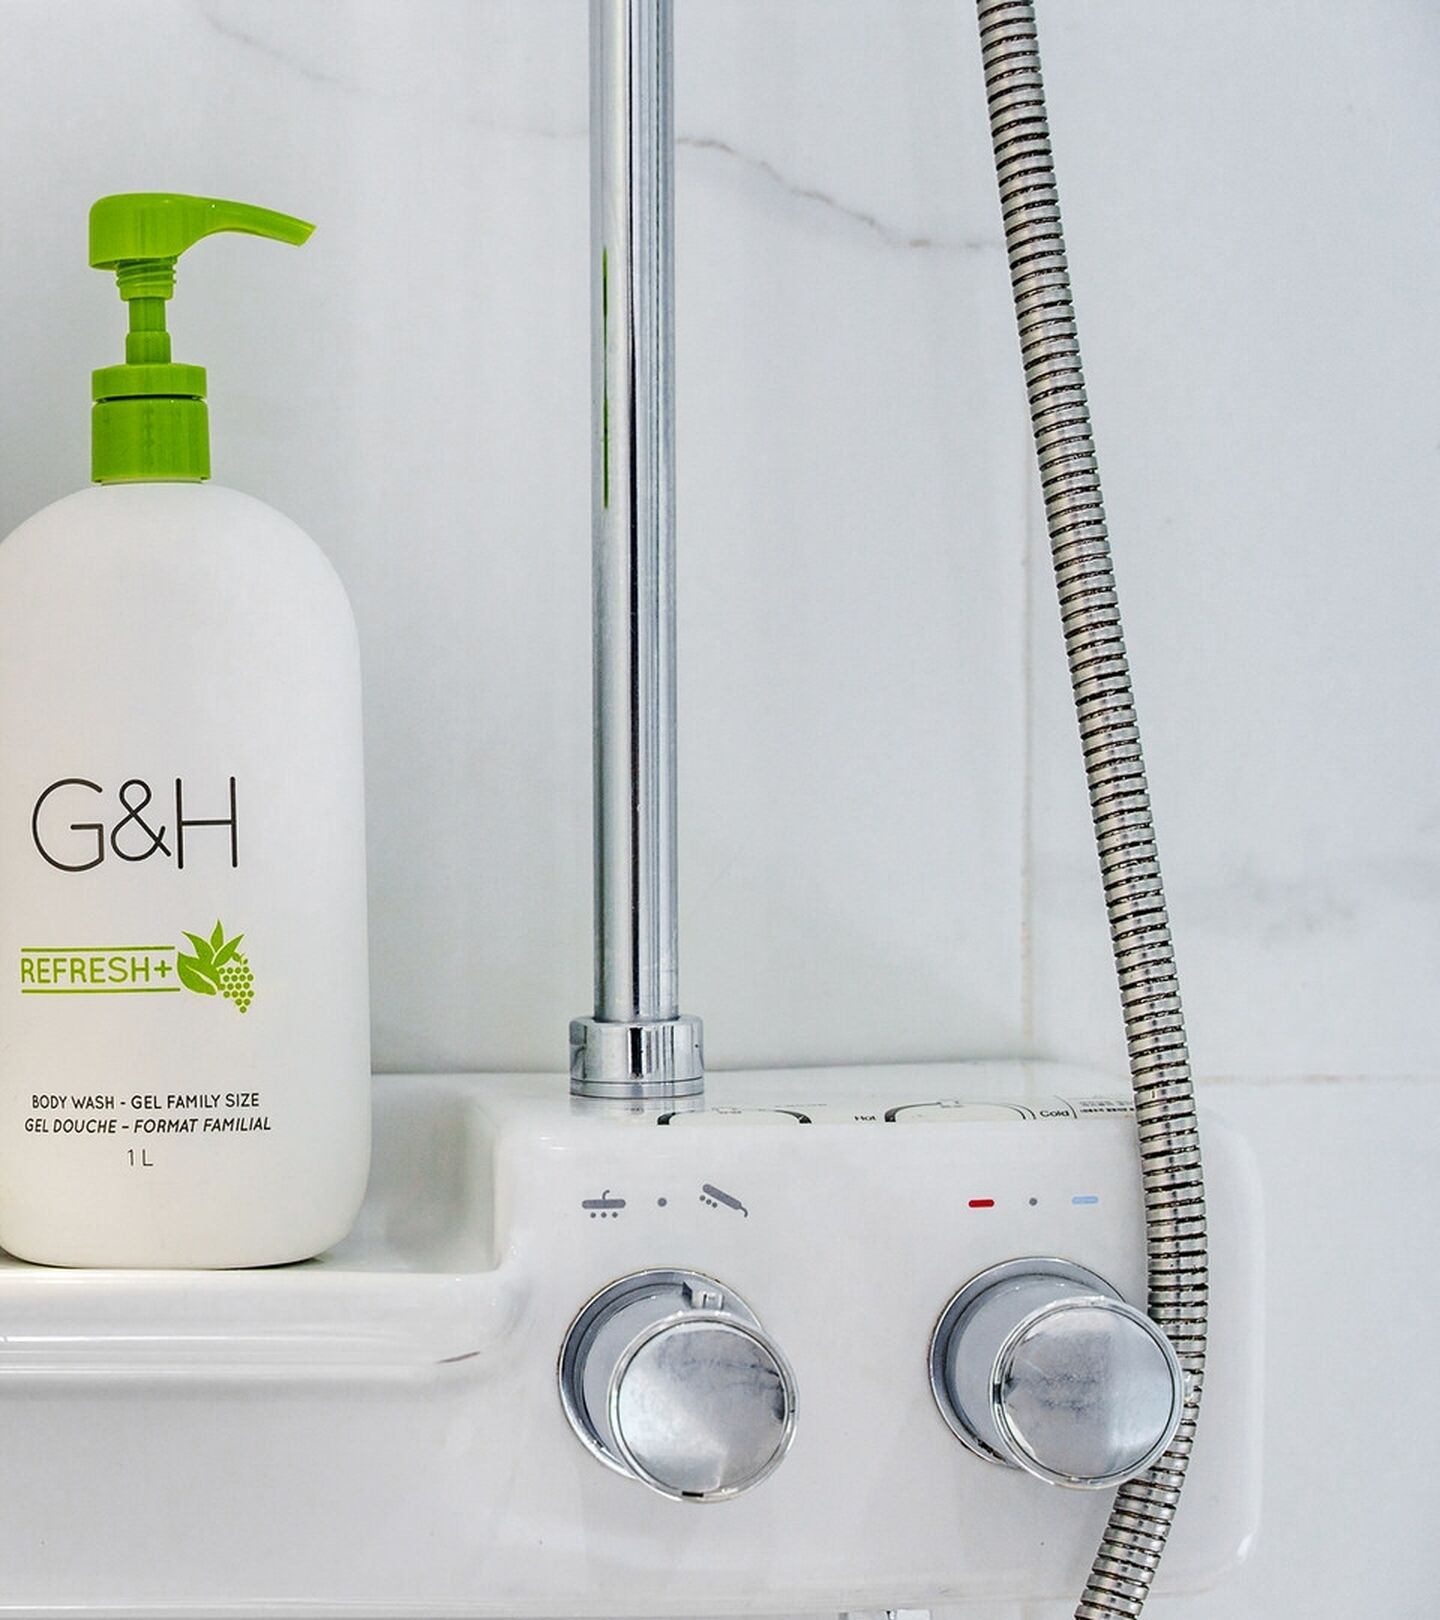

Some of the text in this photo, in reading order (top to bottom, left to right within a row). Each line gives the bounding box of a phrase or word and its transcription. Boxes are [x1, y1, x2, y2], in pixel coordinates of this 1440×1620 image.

[31, 775, 239, 873] G&H
[20, 956, 173, 984] REFRESH+
[32, 1094, 67, 1109] BODY
[71, 1095, 114, 1109] WASH
[131, 1095, 162, 1109] GEL
[167, 1094, 221, 1109] FAMILY
[225, 1093, 259, 1108] SIZE
[1039, 1109, 1070, 1118] Cold
[24, 1118, 49, 1132] GEL
[53, 1118, 117, 1133] DOUCHE
[134, 1118, 199, 1133] FORMAT
[203, 1117, 271, 1132] FAMILIAL
[127, 1149, 154, 1166] 1 L
